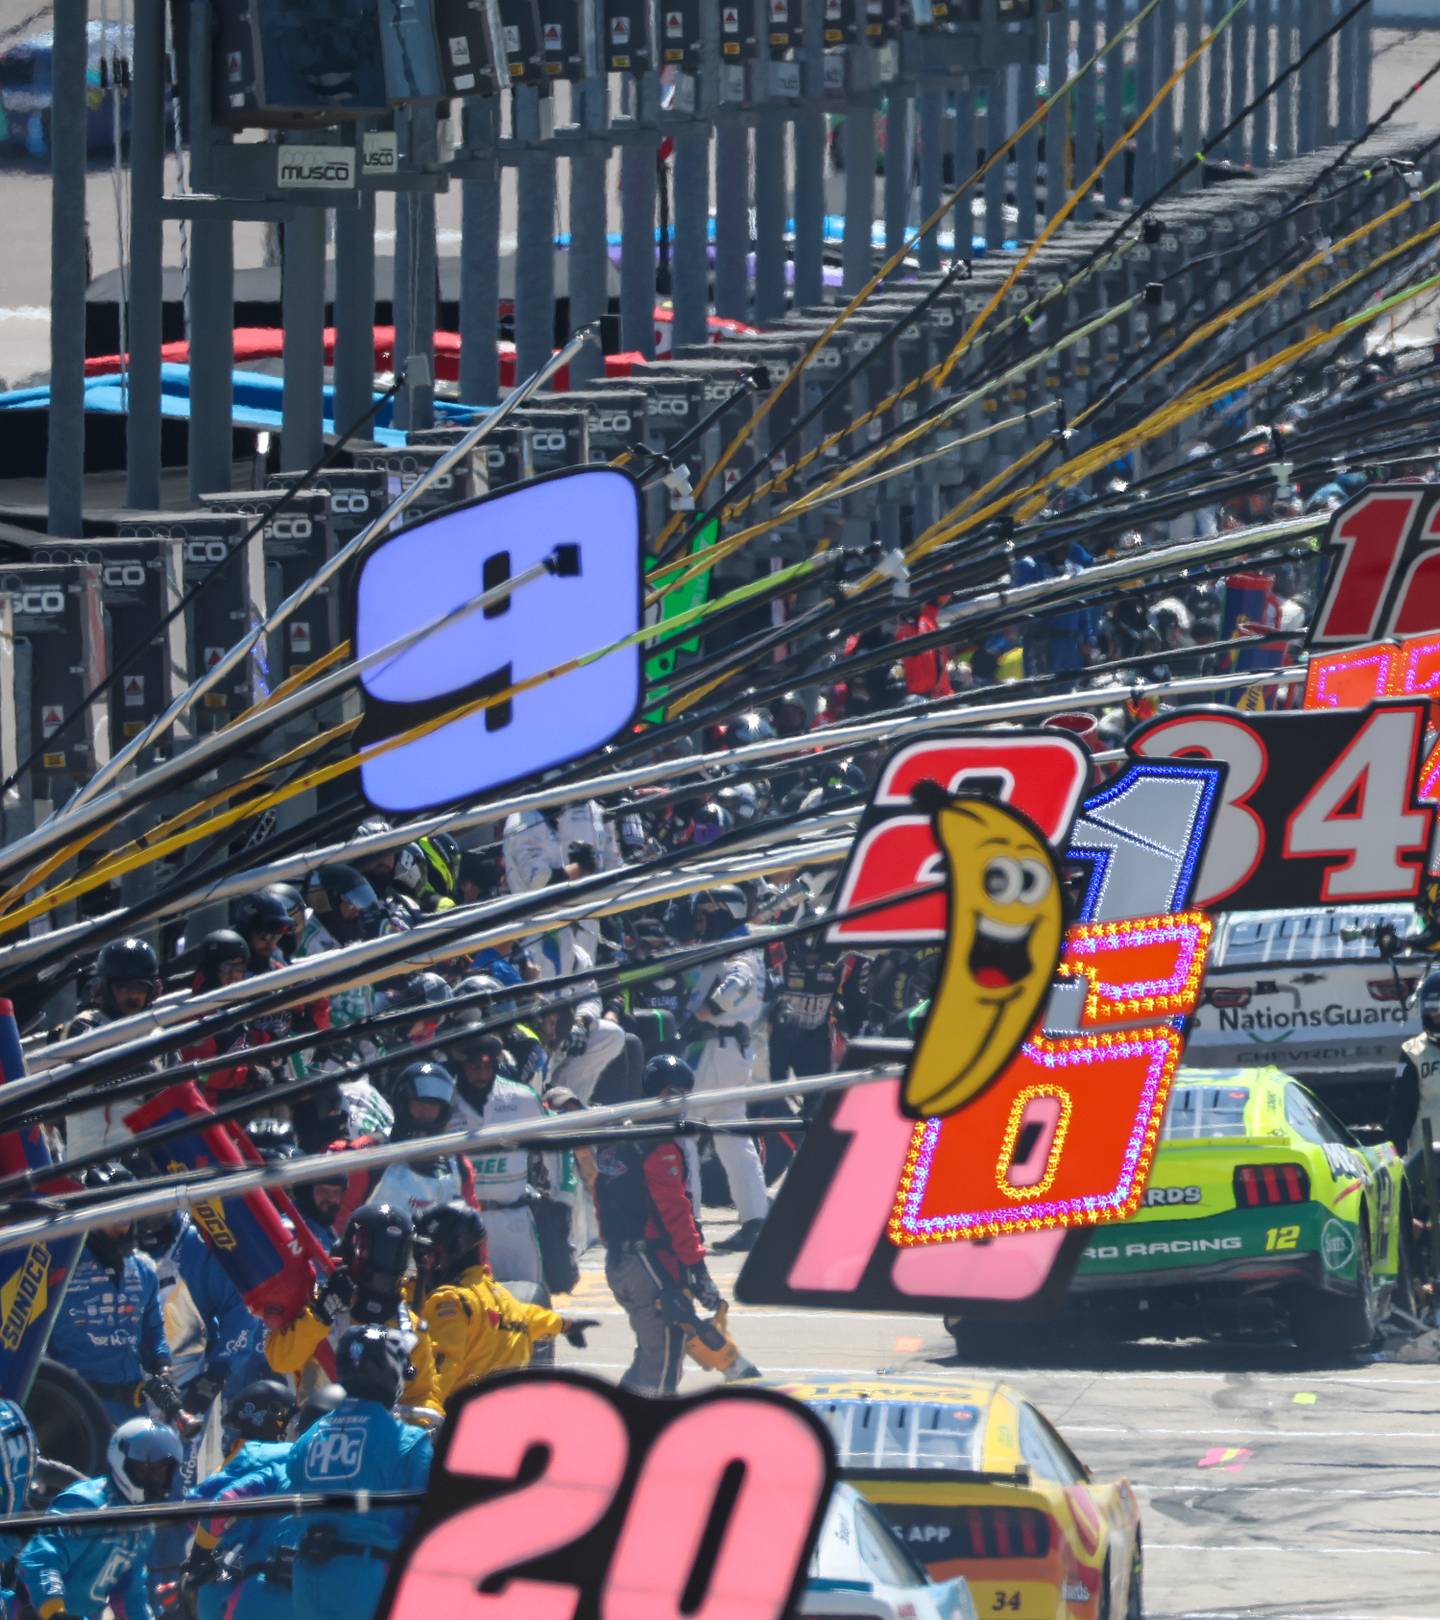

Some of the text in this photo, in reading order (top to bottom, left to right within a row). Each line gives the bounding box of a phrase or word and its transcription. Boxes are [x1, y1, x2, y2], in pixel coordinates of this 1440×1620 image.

[281, 164, 349, 182] MUSCO
[363, 152, 394, 167] USCO
[357, 471, 642, 813] 9
[1130, 706, 1431, 908] 34
[1218, 1001, 1409, 1032] NationsGuard
[1126, 1236, 1243, 1257] RACING
[1265, 1225, 1301, 1251] 12
[2, 1243, 50, 1345] SUNOCO
[308, 1433, 361, 1473] PPG
[388, 1380, 826, 1620] 20
[908, 1526, 952, 1542] APP
[991, 1591, 1022, 1612] 34
